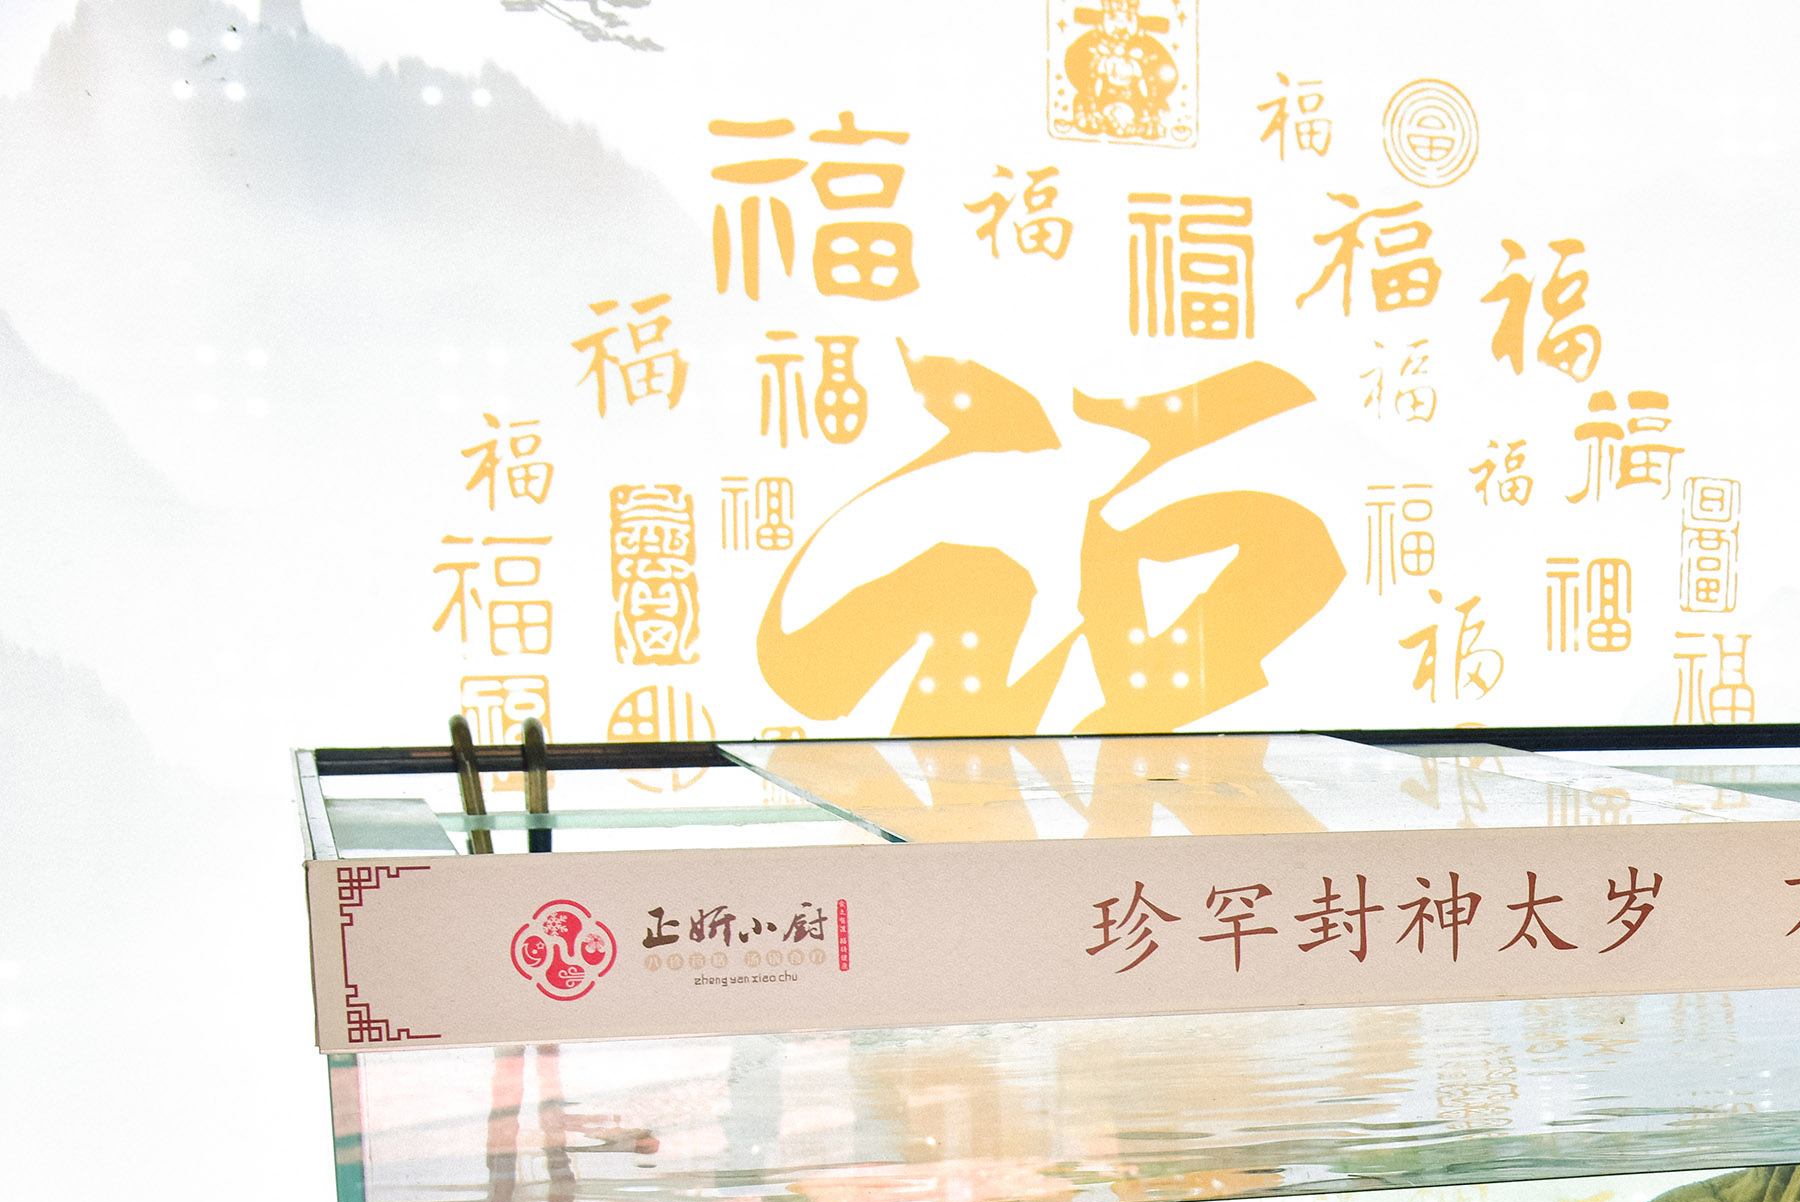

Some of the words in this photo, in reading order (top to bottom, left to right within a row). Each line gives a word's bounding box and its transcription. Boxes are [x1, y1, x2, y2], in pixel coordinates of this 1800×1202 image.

[1257, 72, 1332, 160] 福
[708, 110, 920, 301] 福
[964, 165, 1073, 260] 福
[1296, 192, 1442, 316] 福
[571, 293, 689, 418] 福
[1480, 238, 1602, 382] 福
[756, 330, 868, 448] 福
[1360, 339, 1437, 422] 福
[461, 413, 554, 510] 福
[1470, 440, 1533, 505] 福
[1566, 390, 1685, 503] 福
[433, 534, 552, 656] 福
[1365, 482, 1435, 598] 福
[1399, 589, 1504, 702] 福
[1086, 867, 1662, 974] 珍罕封神太岁
[694, 974, 728, 987] zheng
[730, 976, 750, 984] yan
[751, 973, 776, 983] xiao
[778, 970, 798, 982] chu
